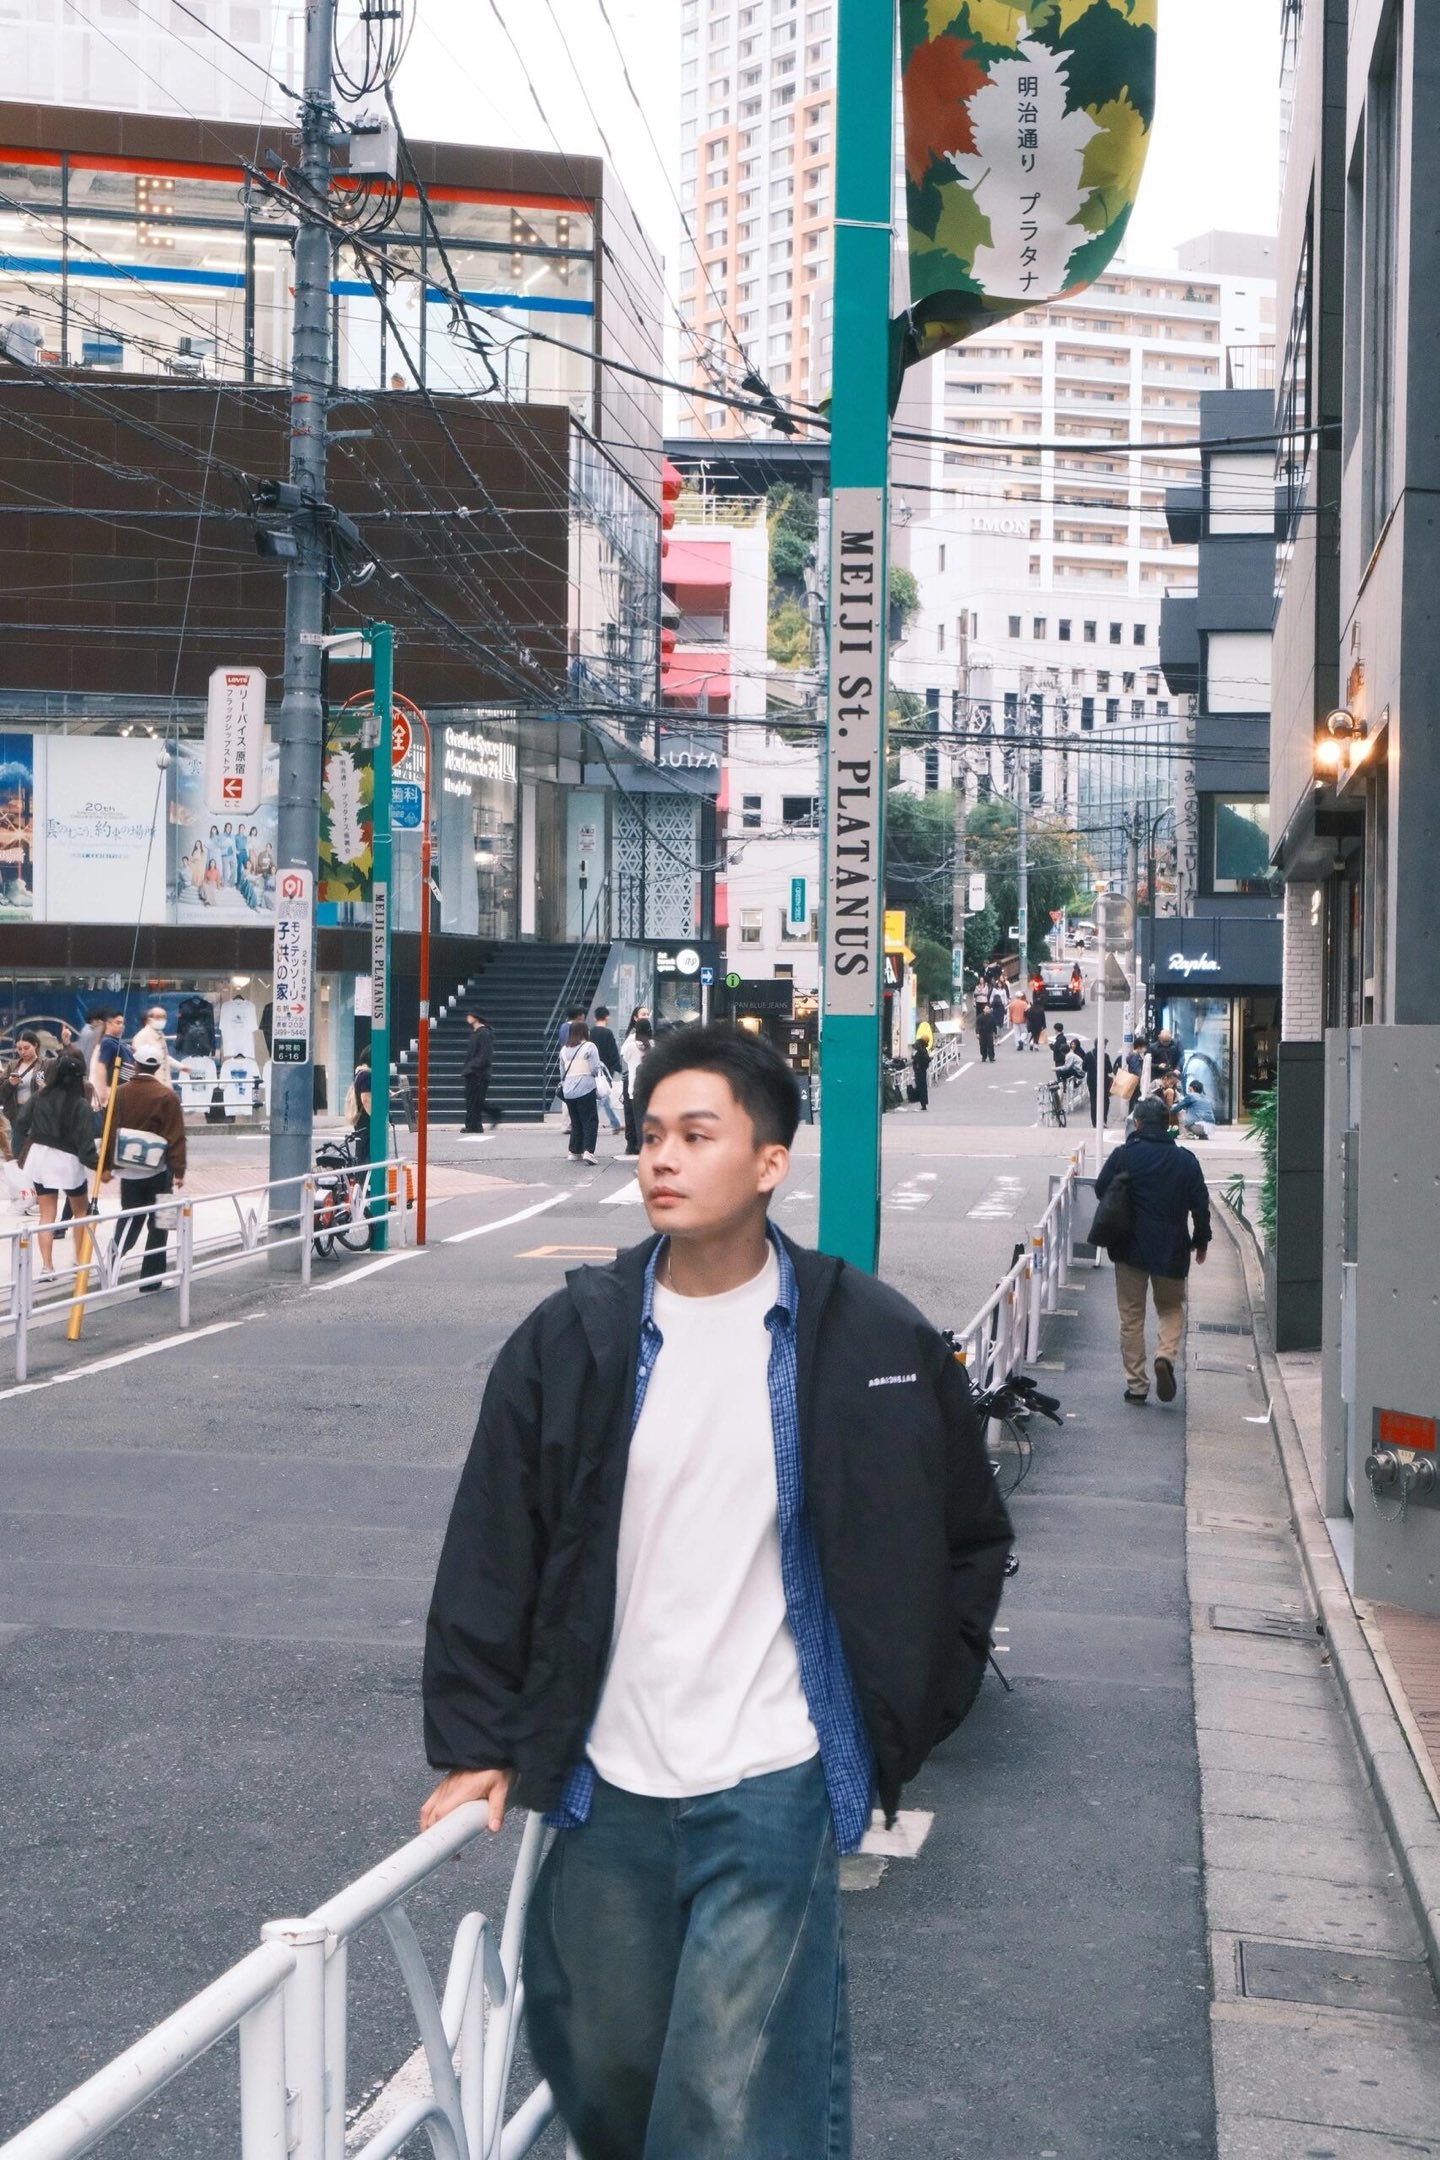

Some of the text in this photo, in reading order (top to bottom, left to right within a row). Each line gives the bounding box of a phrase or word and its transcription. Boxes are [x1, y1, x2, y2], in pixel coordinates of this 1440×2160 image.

[1017, 75, 1039, 174] 明治通り
[833, 529, 874, 977] MEIJI St. PLATANUS
[375, 894, 385, 930] MEIJI
[374, 959, 384, 1020] PLATANUS
